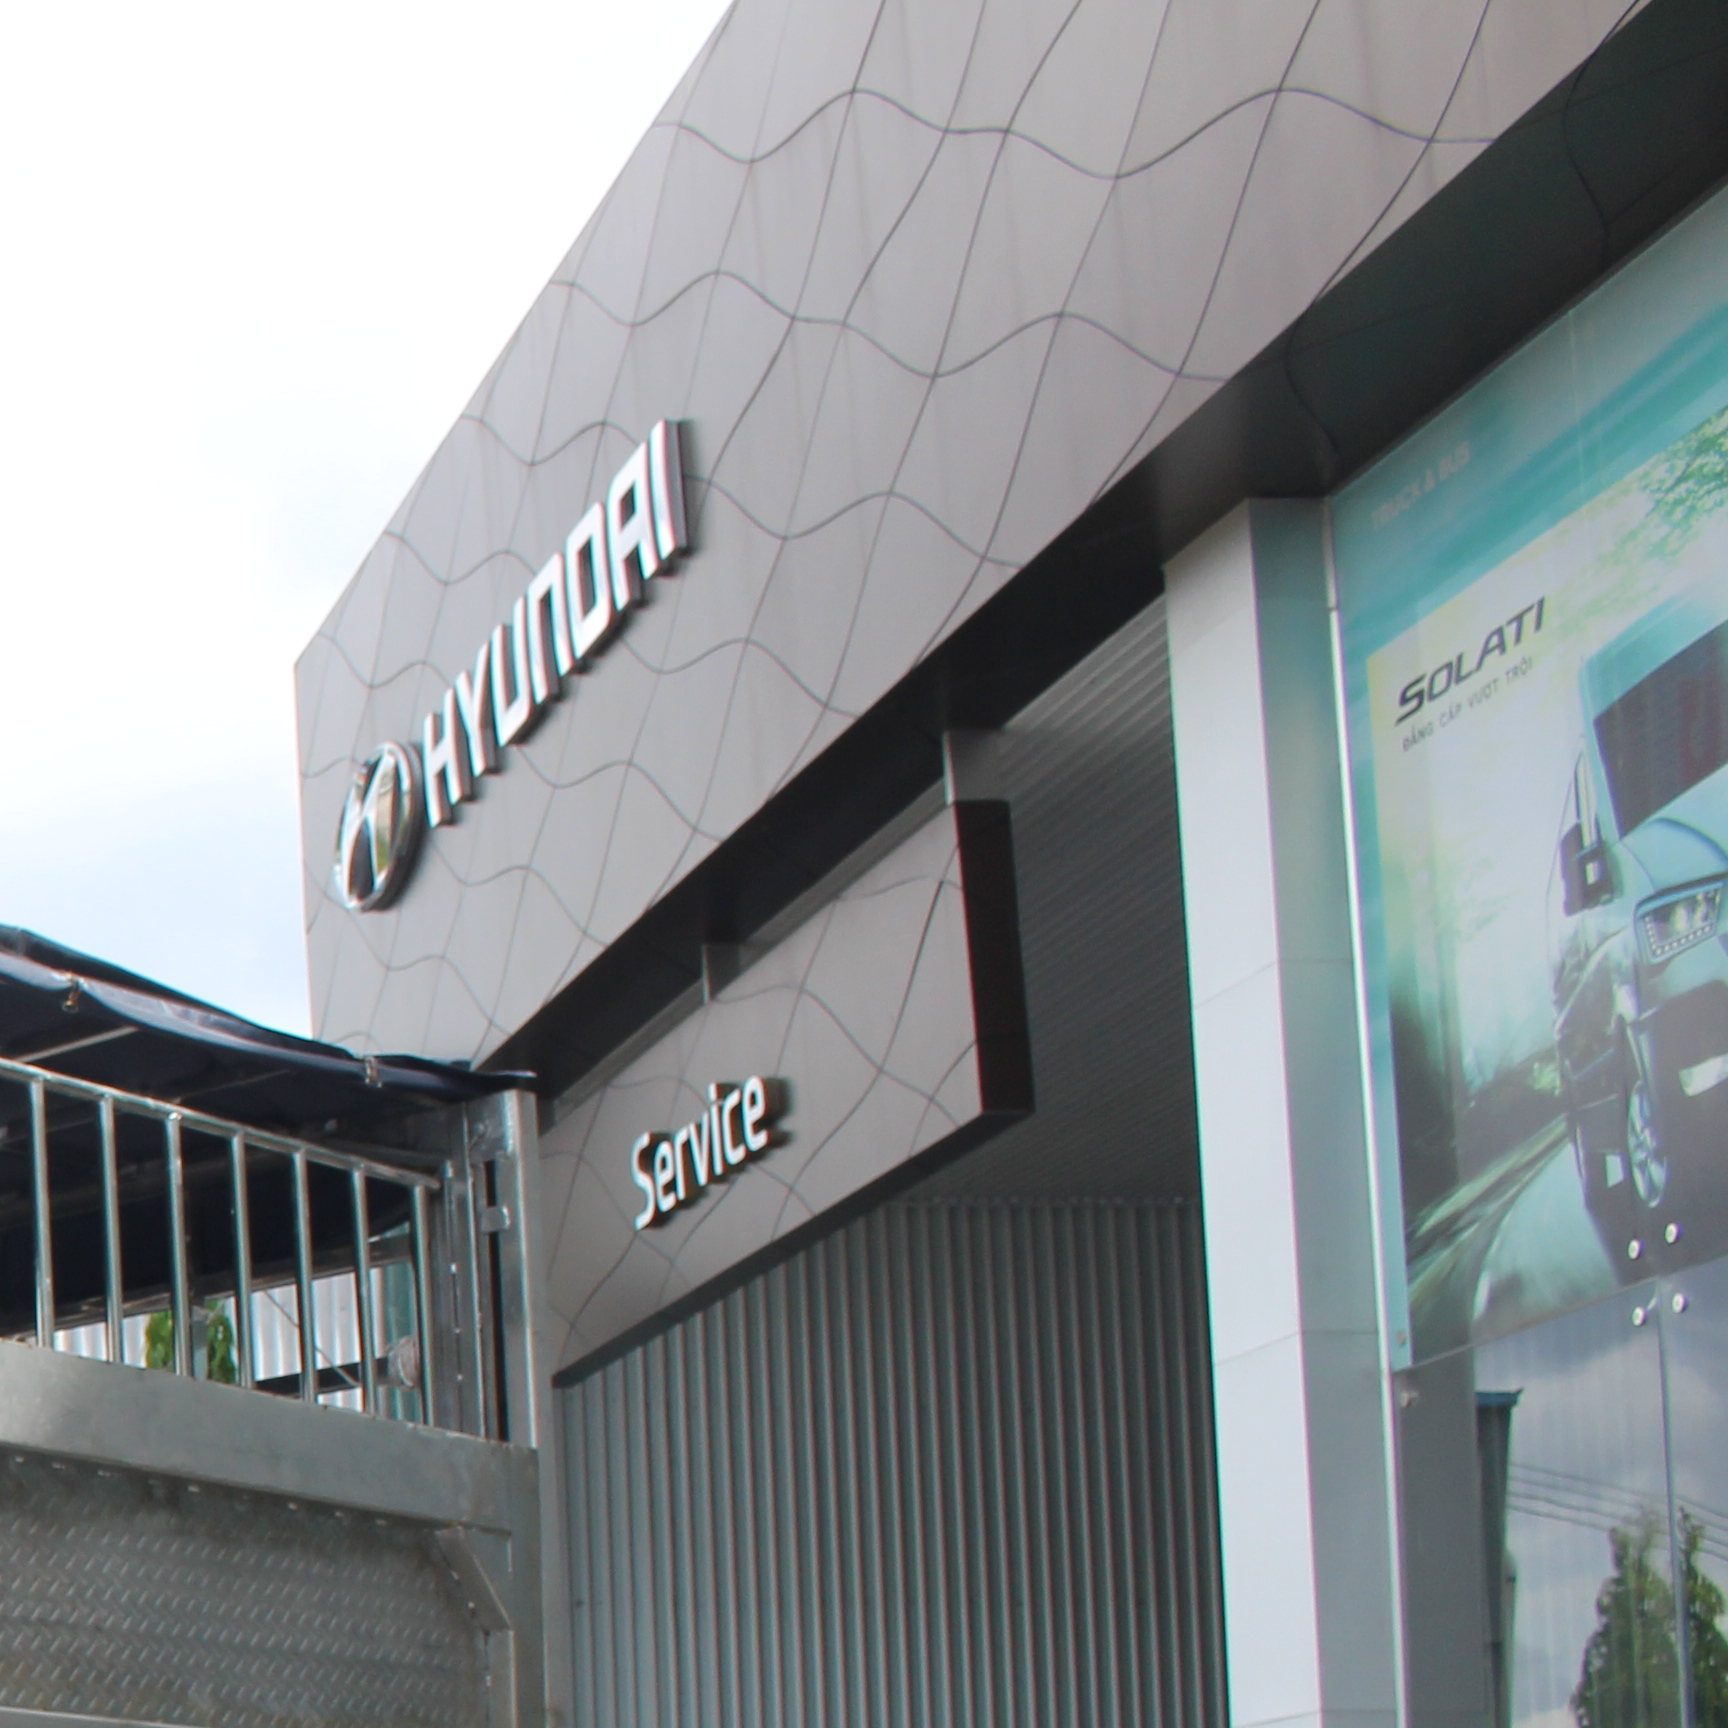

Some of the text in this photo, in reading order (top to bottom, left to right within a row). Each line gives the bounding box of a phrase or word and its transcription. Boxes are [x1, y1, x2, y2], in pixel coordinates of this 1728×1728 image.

[422, 418, 690, 828] HYUNDAI
[1394, 596, 1544, 727] SOLATI
[630, 1074, 770, 1231] Service
